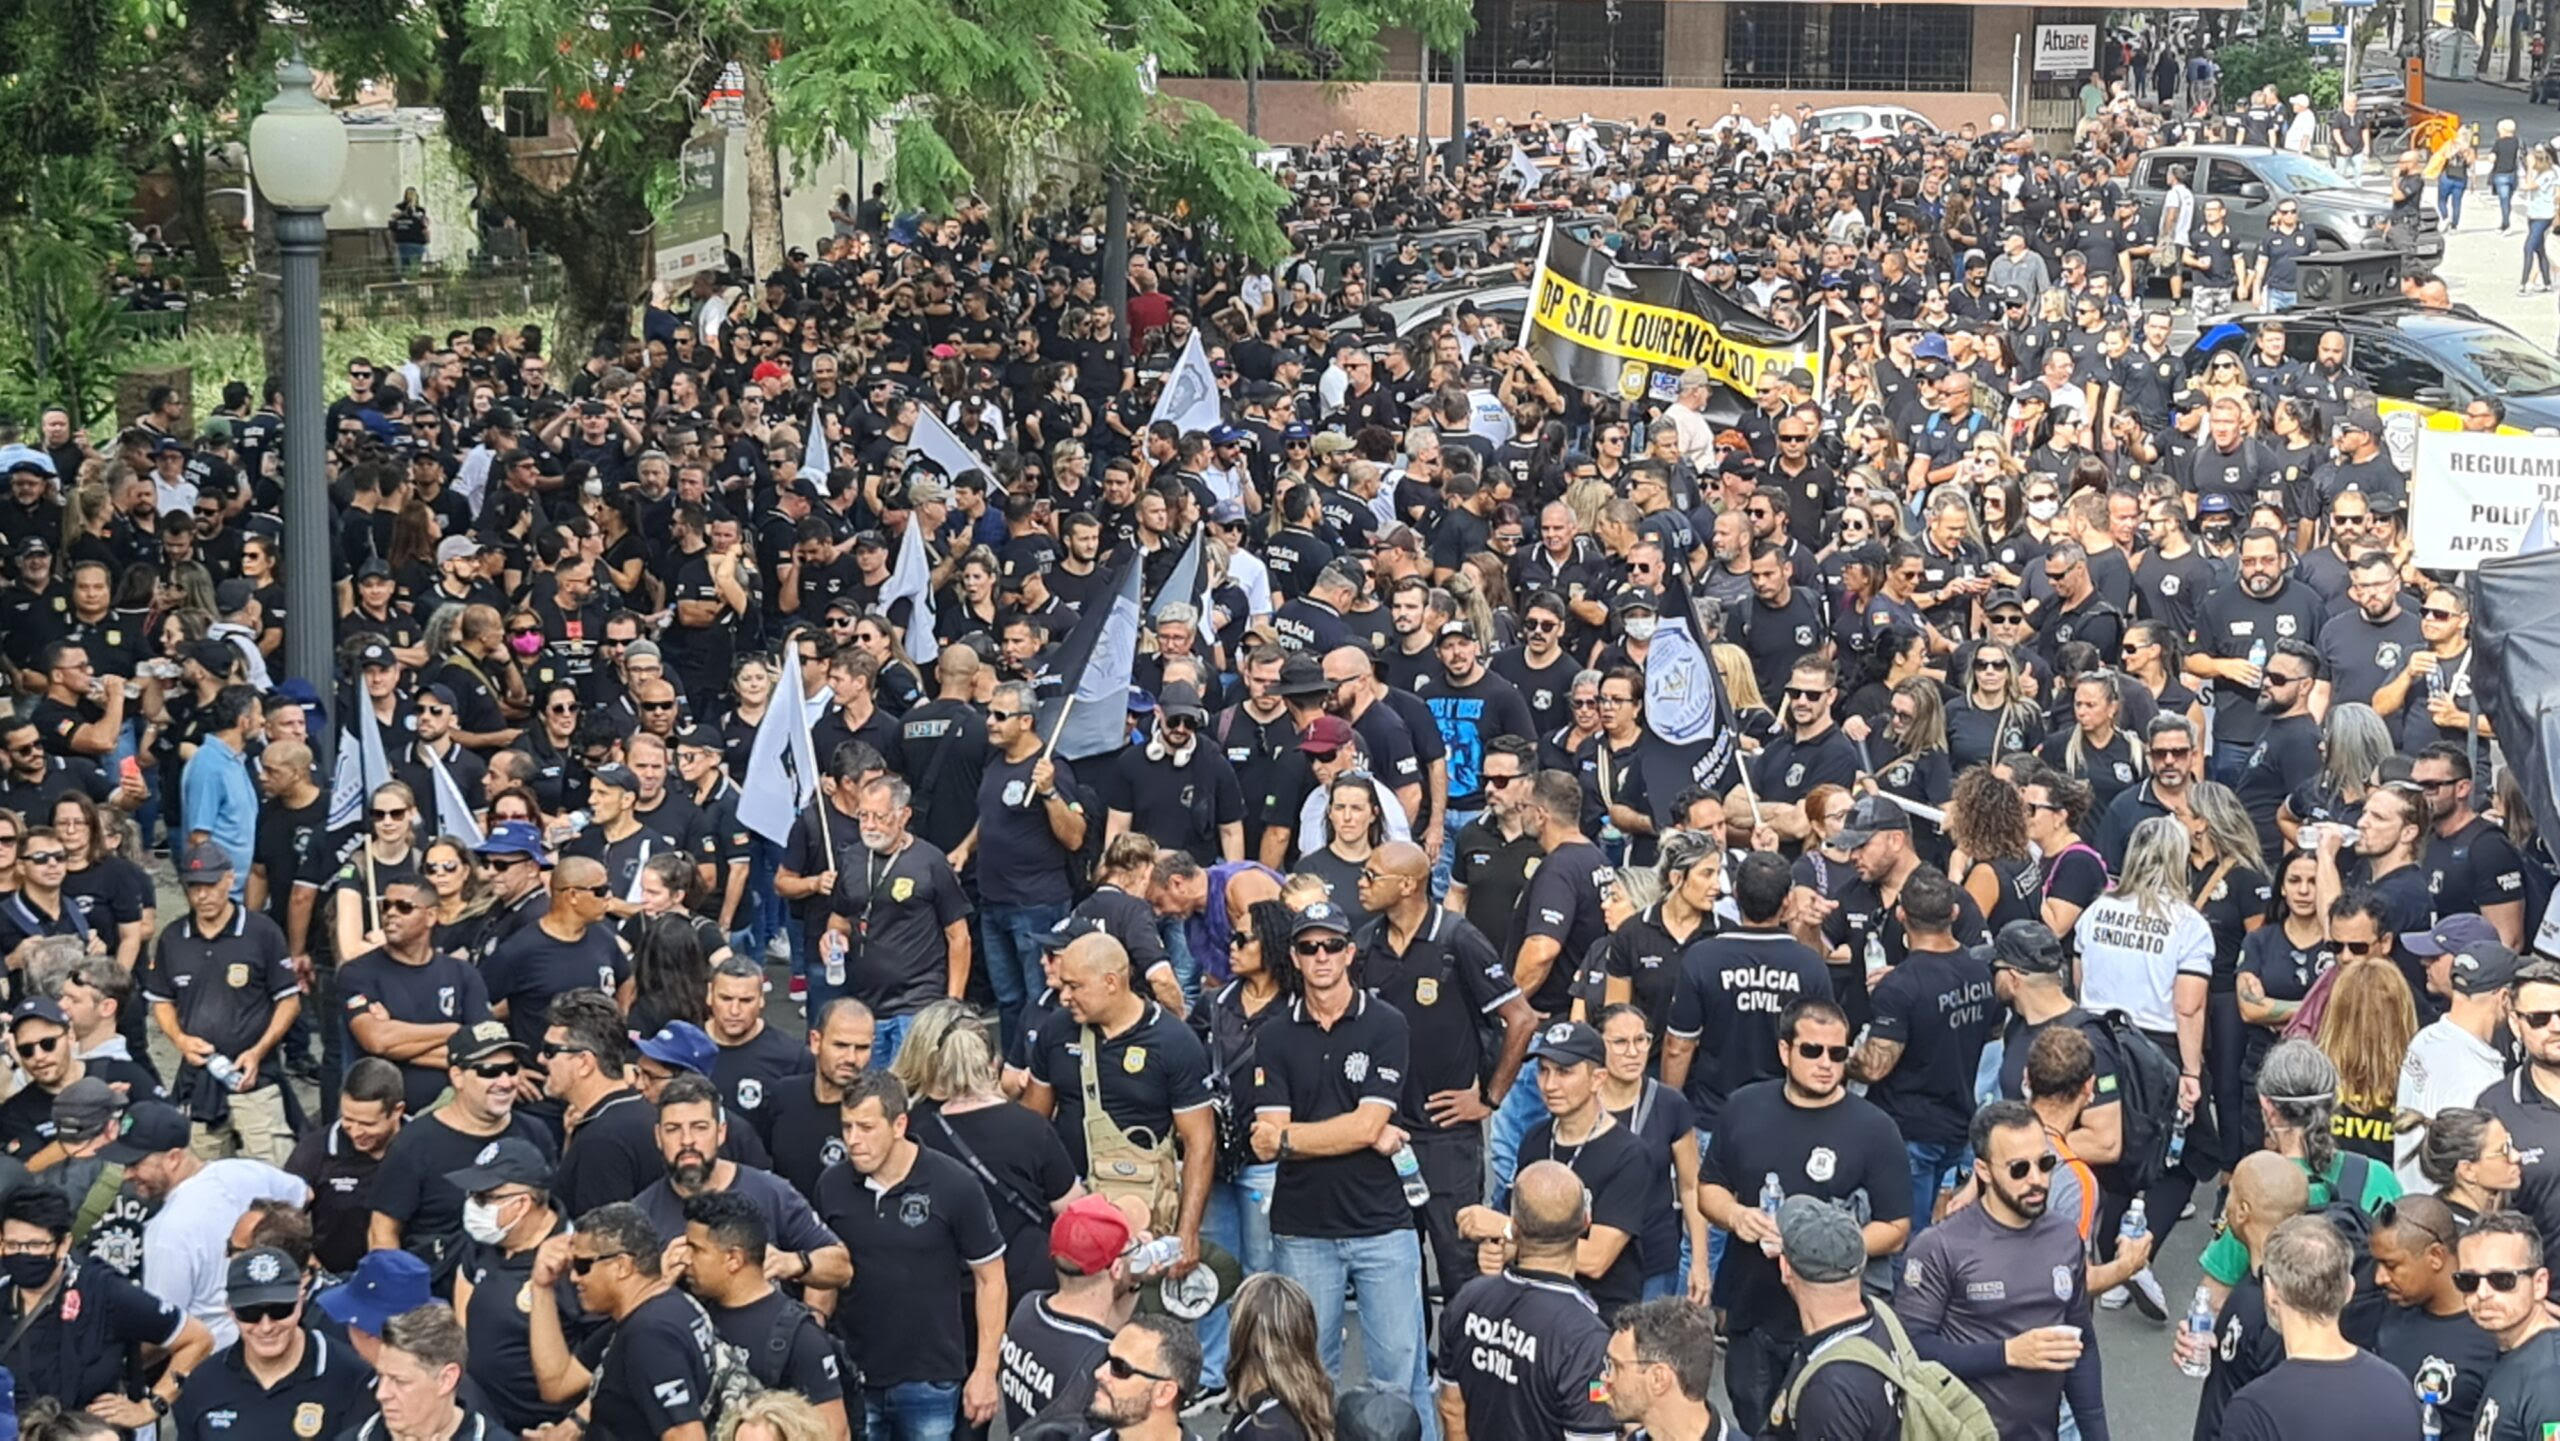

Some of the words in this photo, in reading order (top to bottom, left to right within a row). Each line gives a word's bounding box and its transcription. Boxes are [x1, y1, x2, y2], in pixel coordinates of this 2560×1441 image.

[2042, 26, 2090, 52] Atuare
[1565, 290, 1613, 341] SÃO
[1728, 348, 1755, 387] DO
[2450, 451, 2560, 478] REGULAM
[2470, 503, 2560, 528] POLÍCA
[2092, 926, 2165, 955] SINDICATO
[1720, 964, 1801, 993] POLÍCIA
[1736, 991, 1783, 1013] CIVIL
[1938, 981, 1994, 1013] POLÍCIA
[1949, 1005, 1984, 1029] CIVIL
[2330, 1113, 2395, 1141] CIVIL
[1464, 1311, 1538, 1363] POLÍCIA
[1471, 1346, 1519, 1385] CIVIL
[1001, 1367, 1037, 1418] CIVIL
